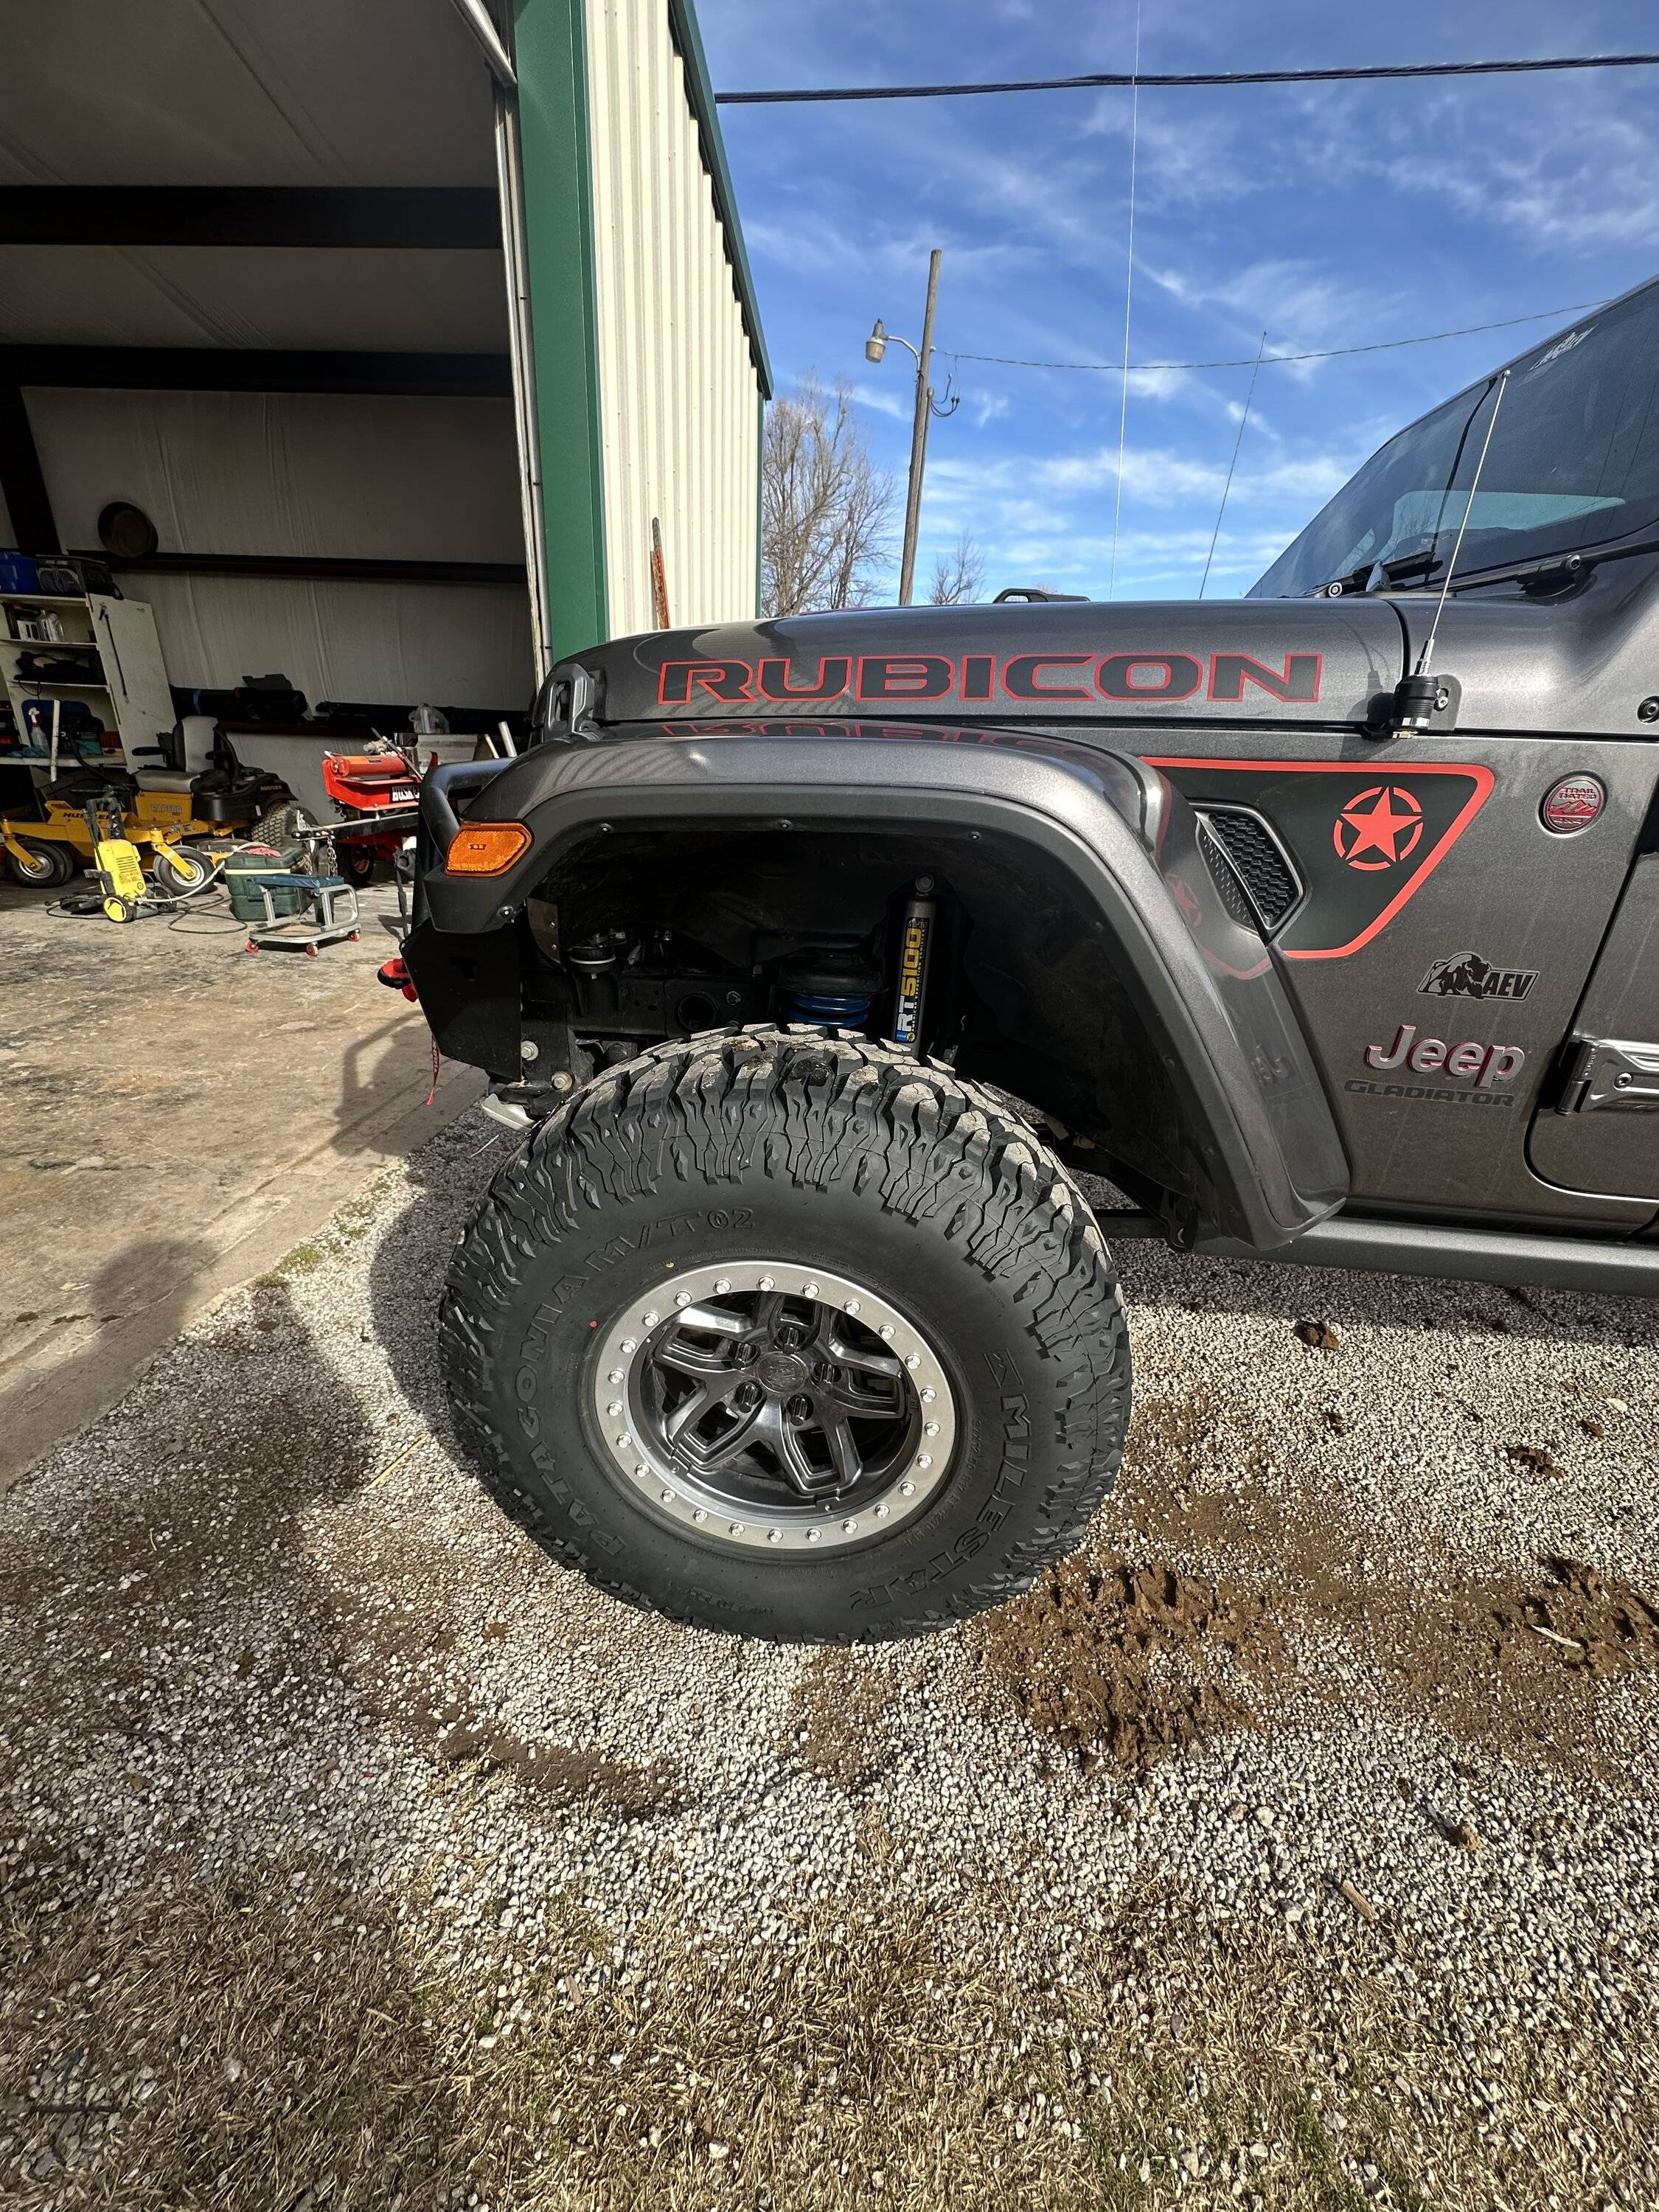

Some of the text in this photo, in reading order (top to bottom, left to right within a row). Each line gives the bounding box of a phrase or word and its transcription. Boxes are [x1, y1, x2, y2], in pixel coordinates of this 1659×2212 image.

[658, 652, 1322, 705] RUBICON
[1482, 972, 1534, 996] AEV
[1366, 1024, 1525, 1088] Jeep
[1343, 1079, 1514, 1107] GLADIATOR
[515, 1275, 626, 1555] PATAGONIA
[707, 1208, 756, 1230] 02
[850, 1393, 1032, 1610] MILESTAR
